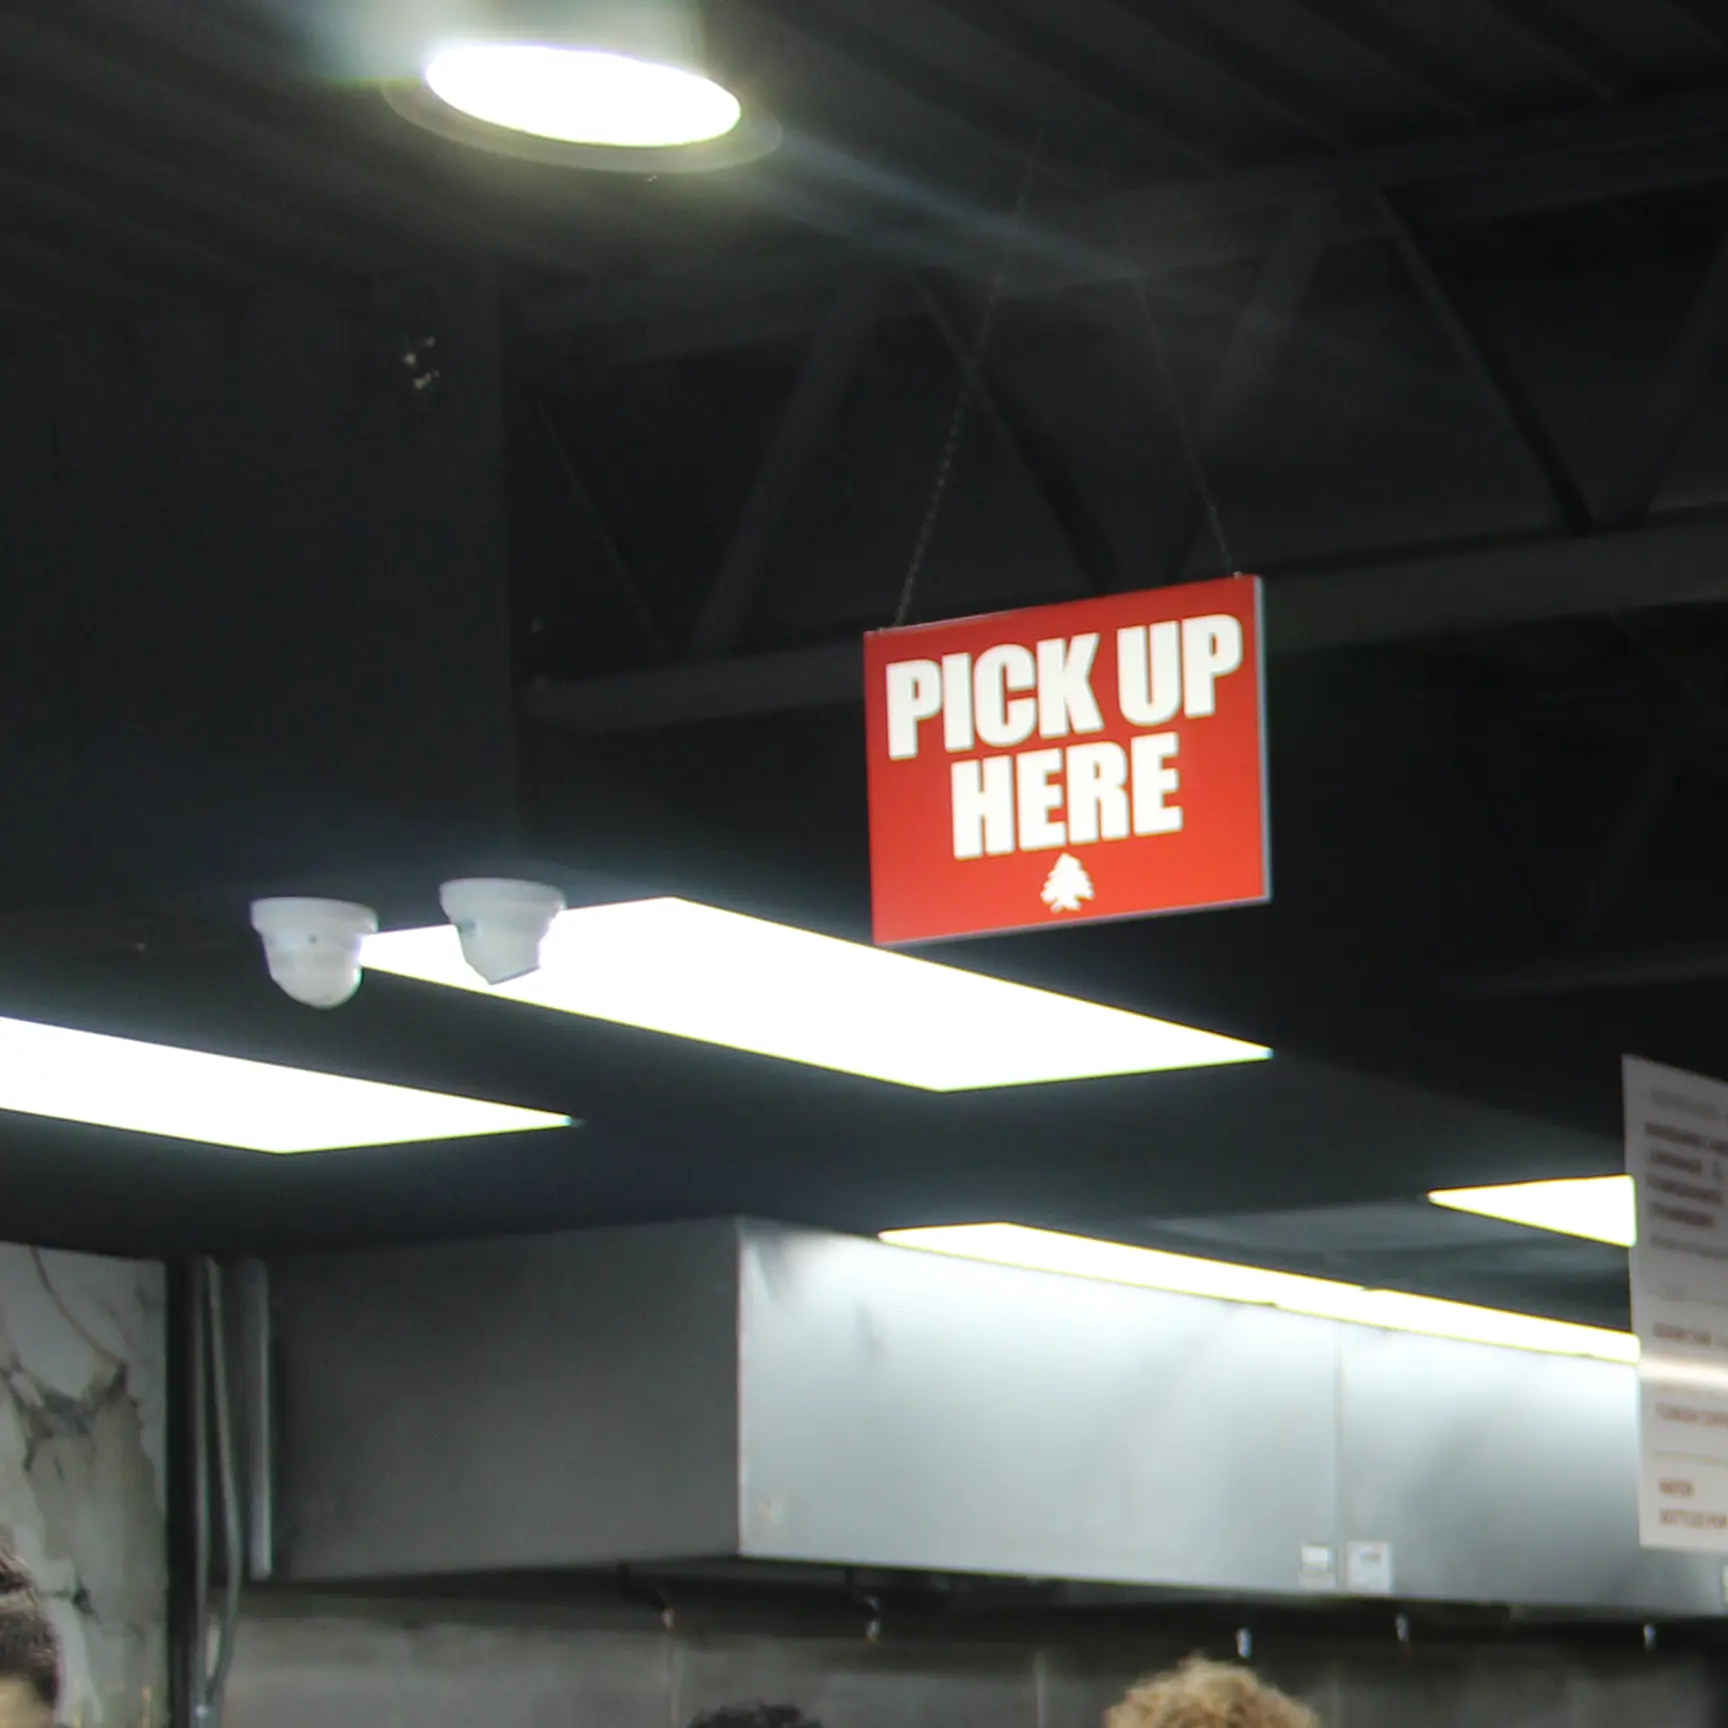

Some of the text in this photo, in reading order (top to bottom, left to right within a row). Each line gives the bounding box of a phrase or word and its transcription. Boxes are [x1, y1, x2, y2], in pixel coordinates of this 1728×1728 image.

[886, 614, 1243, 760] PICK UP
[951, 731, 1184, 860] HERE
